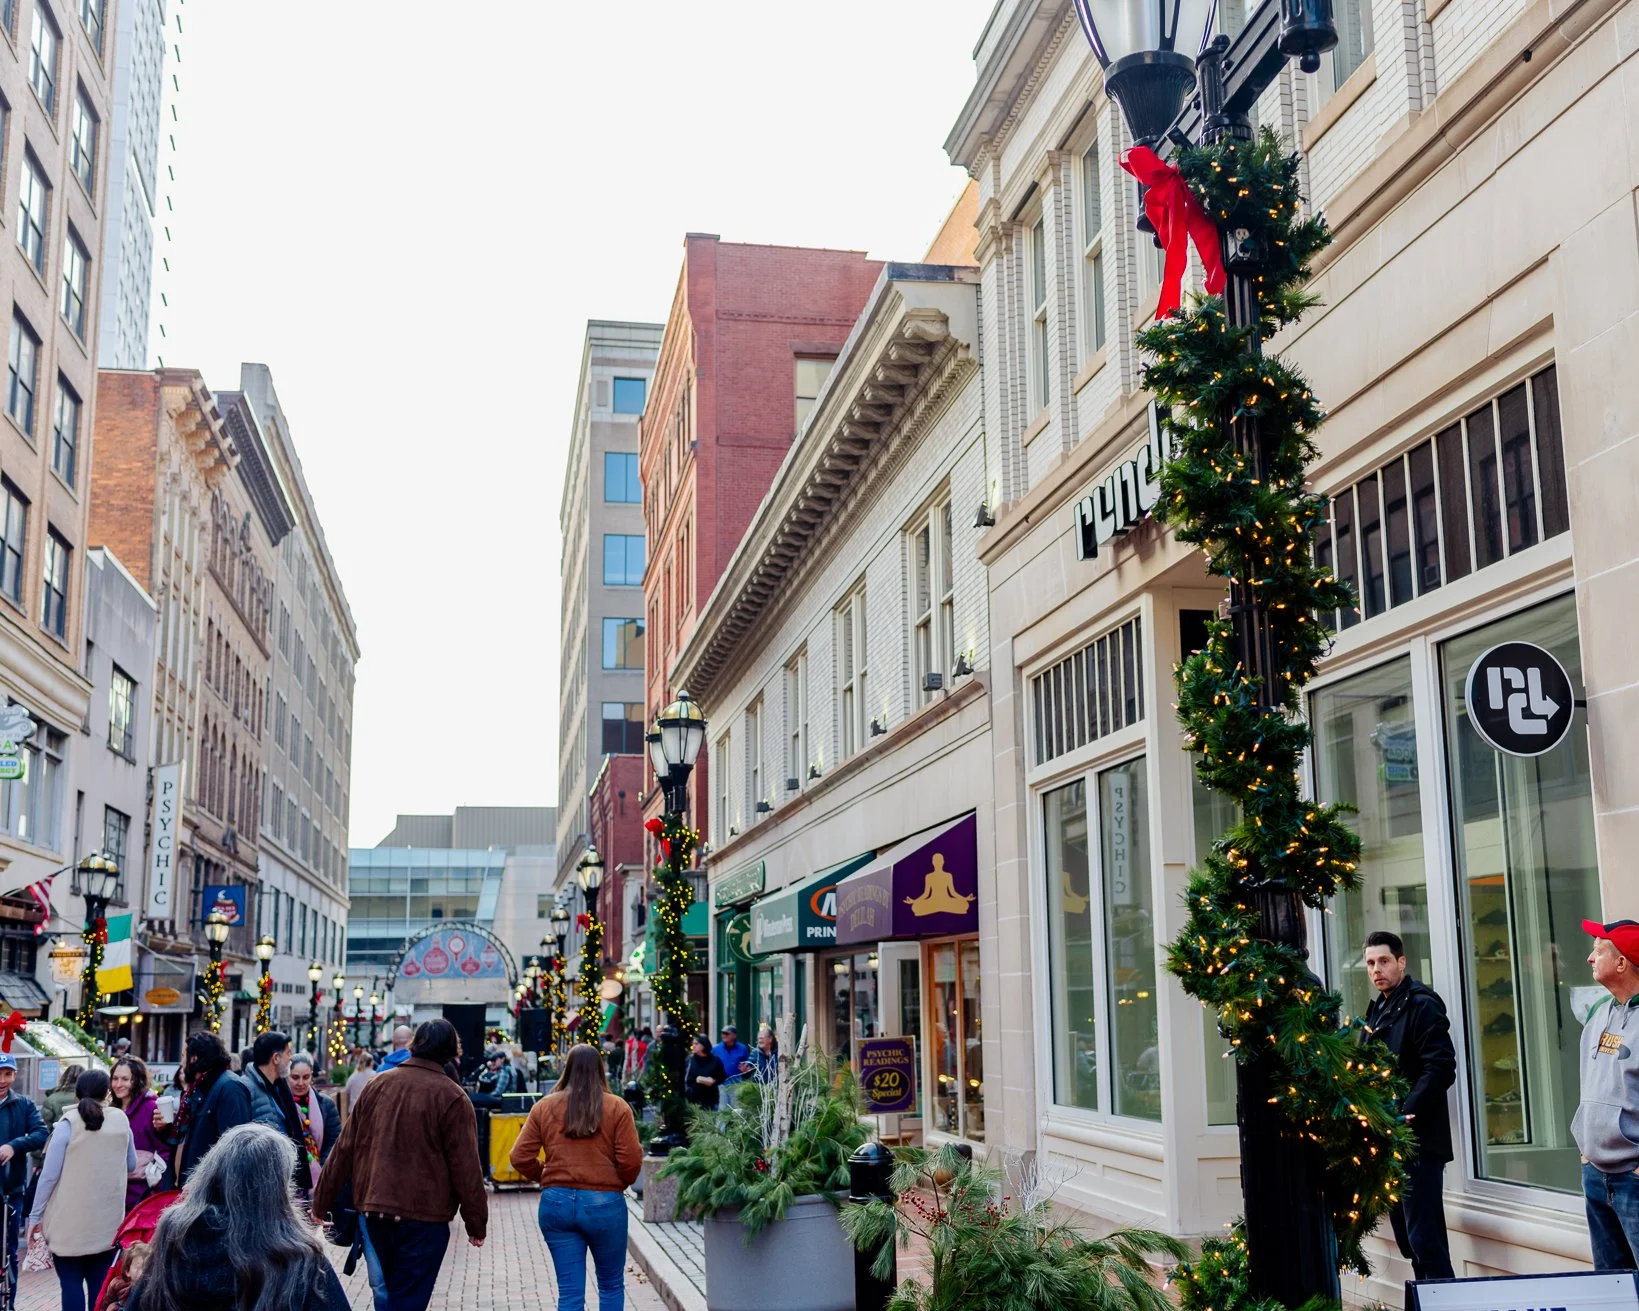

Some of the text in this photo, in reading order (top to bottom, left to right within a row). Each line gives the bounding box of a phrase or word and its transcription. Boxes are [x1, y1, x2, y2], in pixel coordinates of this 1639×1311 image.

[1074, 398, 1181, 561] rynd
[154, 781, 173, 905] PSYCHIC
[807, 926, 837, 937] PRIN
[866, 1049, 904, 1058] PSYCHIC
[863, 1056, 909, 1066] READINGS
[873, 1072, 900, 1087] $20
[872, 1088, 902, 1099] Special
